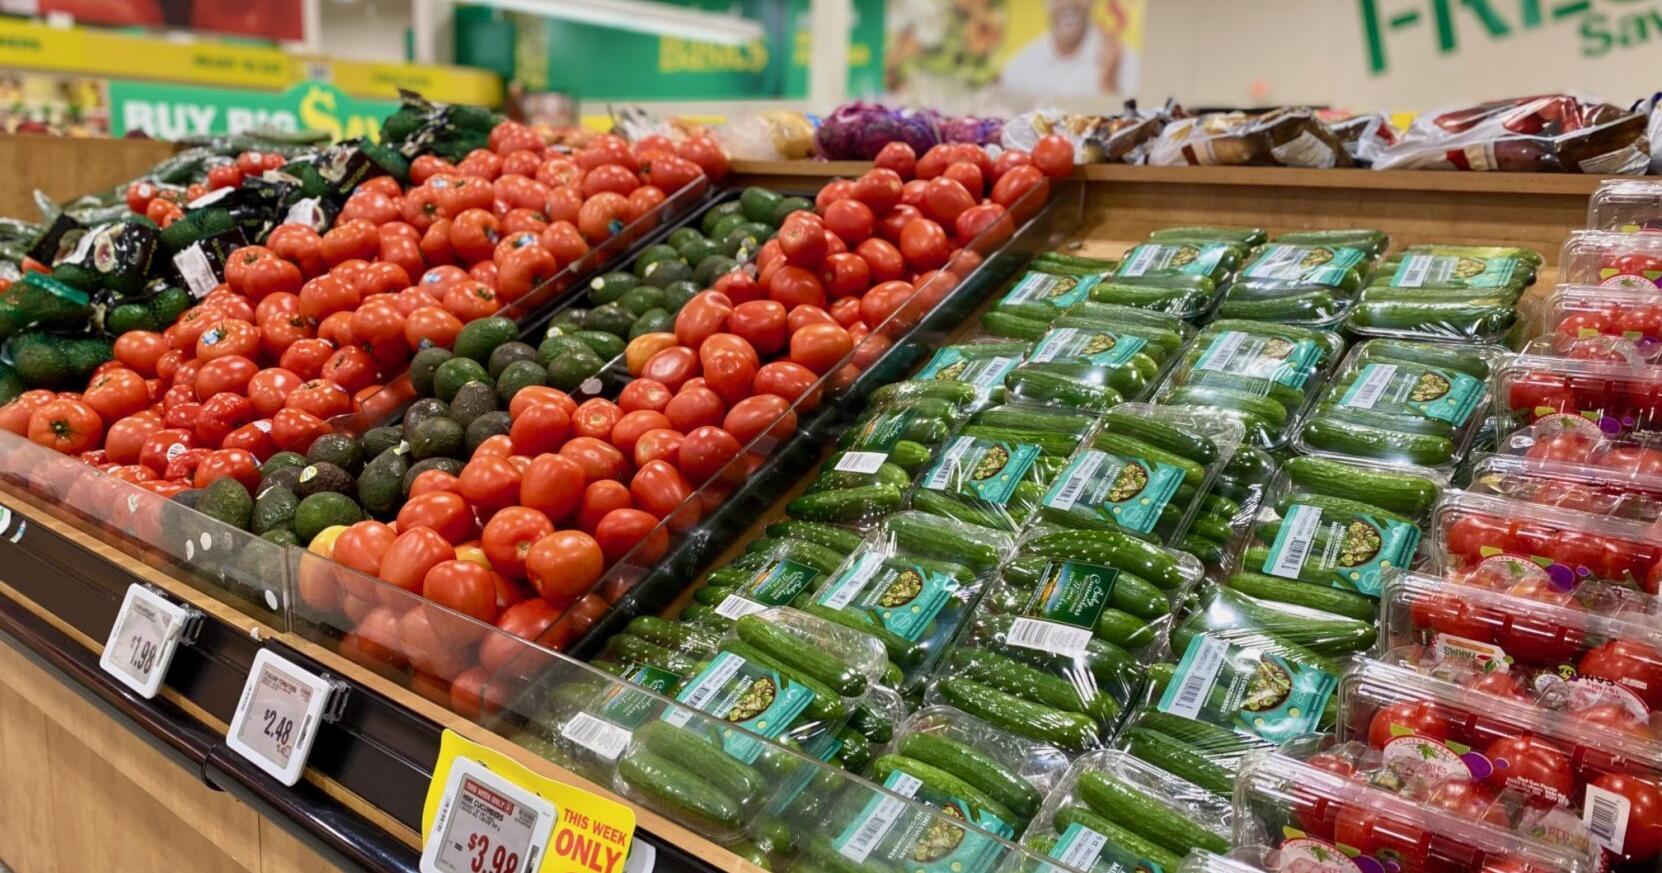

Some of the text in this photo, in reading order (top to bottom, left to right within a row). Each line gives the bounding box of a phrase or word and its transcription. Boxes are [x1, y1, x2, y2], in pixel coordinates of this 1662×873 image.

[122, 99, 217, 142] BUY
[1336, 524, 1346, 540] MINI
[1073, 573, 1101, 616] Cucumbers
[1085, 585, 1105, 608] Baby
[130, 636, 158, 674] $1.98
[1230, 678, 1248, 711] CUCUMBERS
[264, 707, 294, 746] $2.48
[563, 808, 590, 830] THIS
[592, 821, 628, 847] WEEK
[467, 831, 519, 873] $3.98
[554, 828, 623, 873] ONLY
